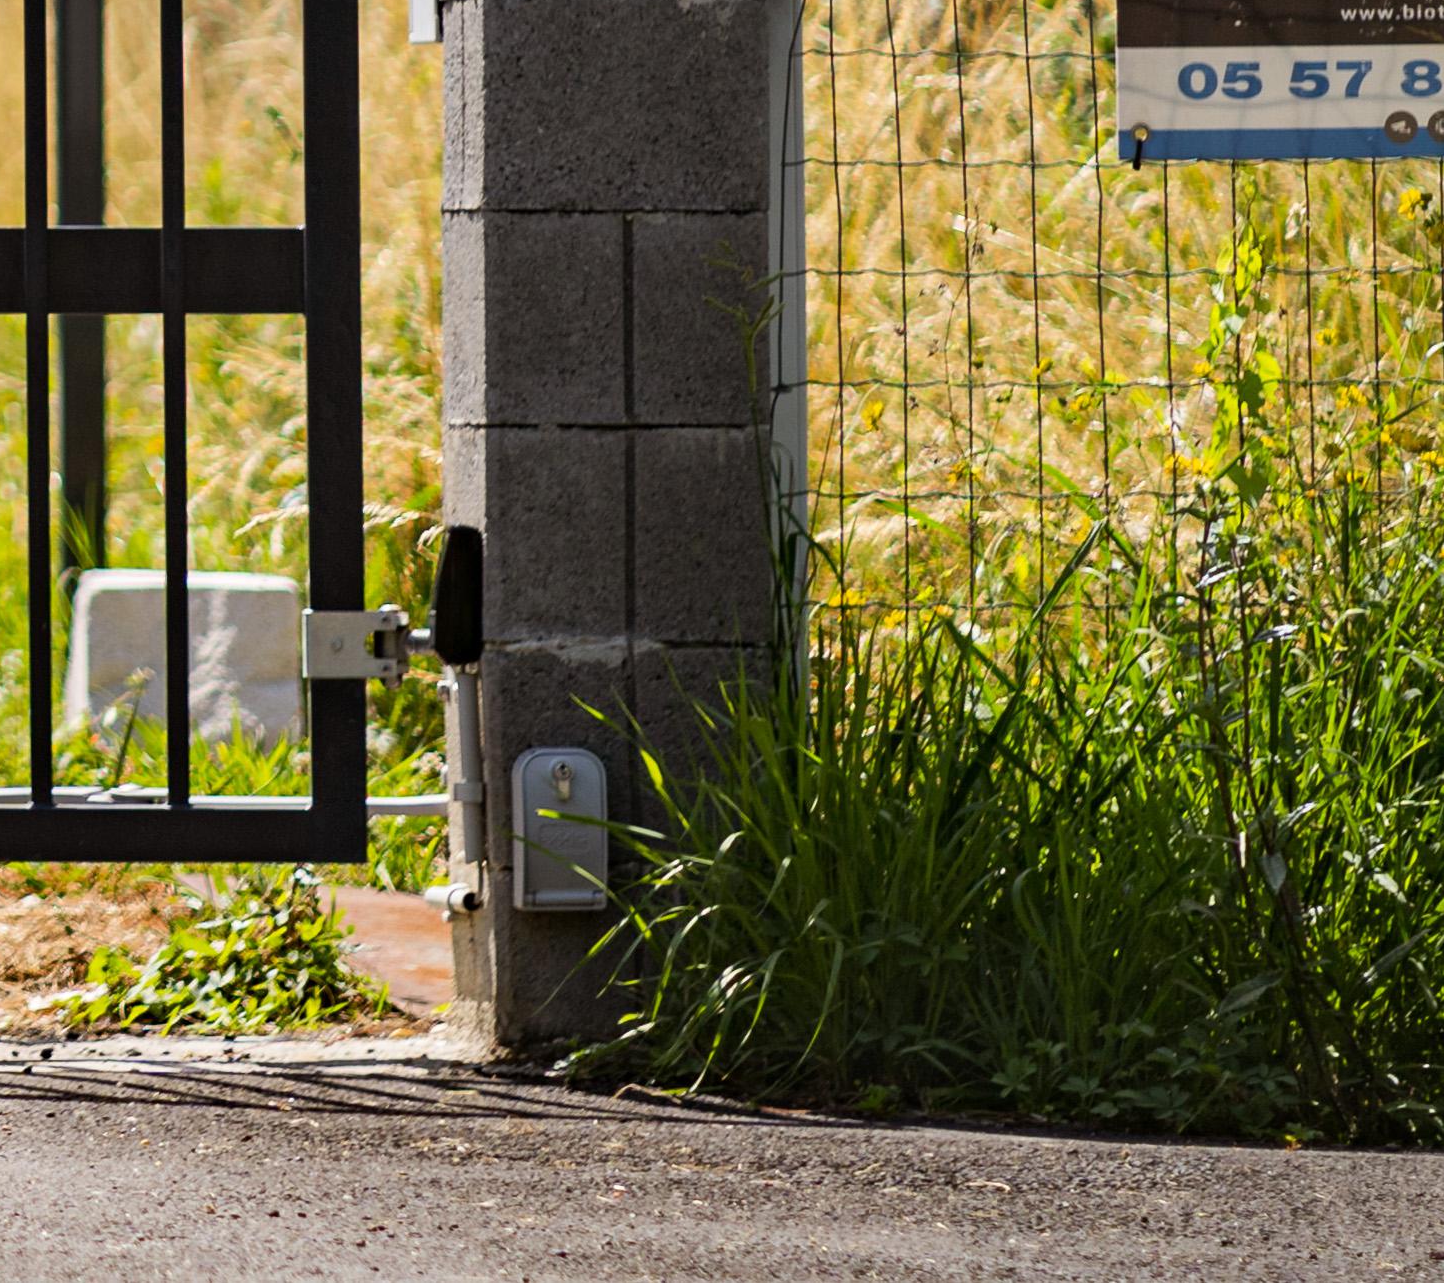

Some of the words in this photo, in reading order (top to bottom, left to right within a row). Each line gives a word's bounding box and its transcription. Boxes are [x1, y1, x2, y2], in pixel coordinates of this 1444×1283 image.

[1177, 61, 1262, 100] 05
[1289, 60, 1372, 99] 57
[1401, 59, 1442, 97] 8
